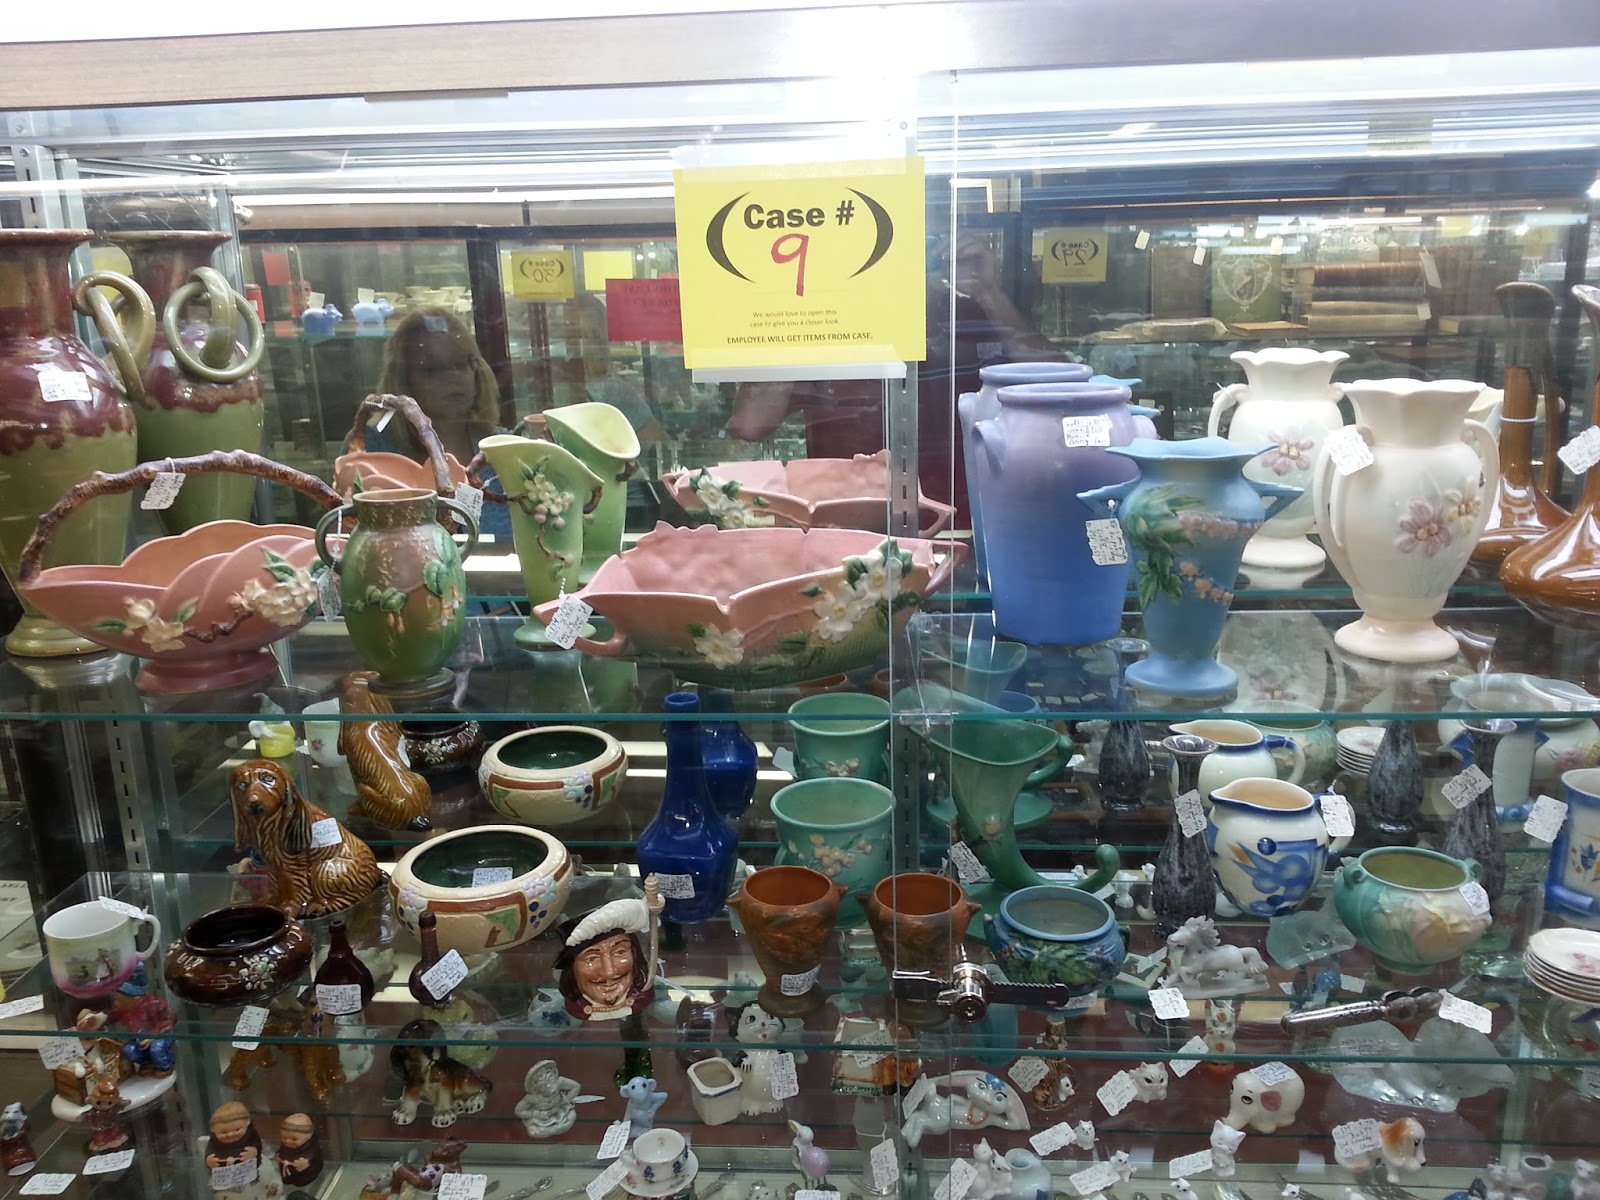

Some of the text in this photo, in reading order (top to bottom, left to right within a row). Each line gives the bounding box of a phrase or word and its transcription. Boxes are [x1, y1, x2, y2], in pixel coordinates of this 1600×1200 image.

[743, 200, 855, 229] Case #
[770, 233, 810, 297] 9
[772, 320, 786, 328] give
[787, 320, 799, 328] you
[727, 331, 874, 344] EMPLOYEE WILL GET ITEMS FROM CASE.
